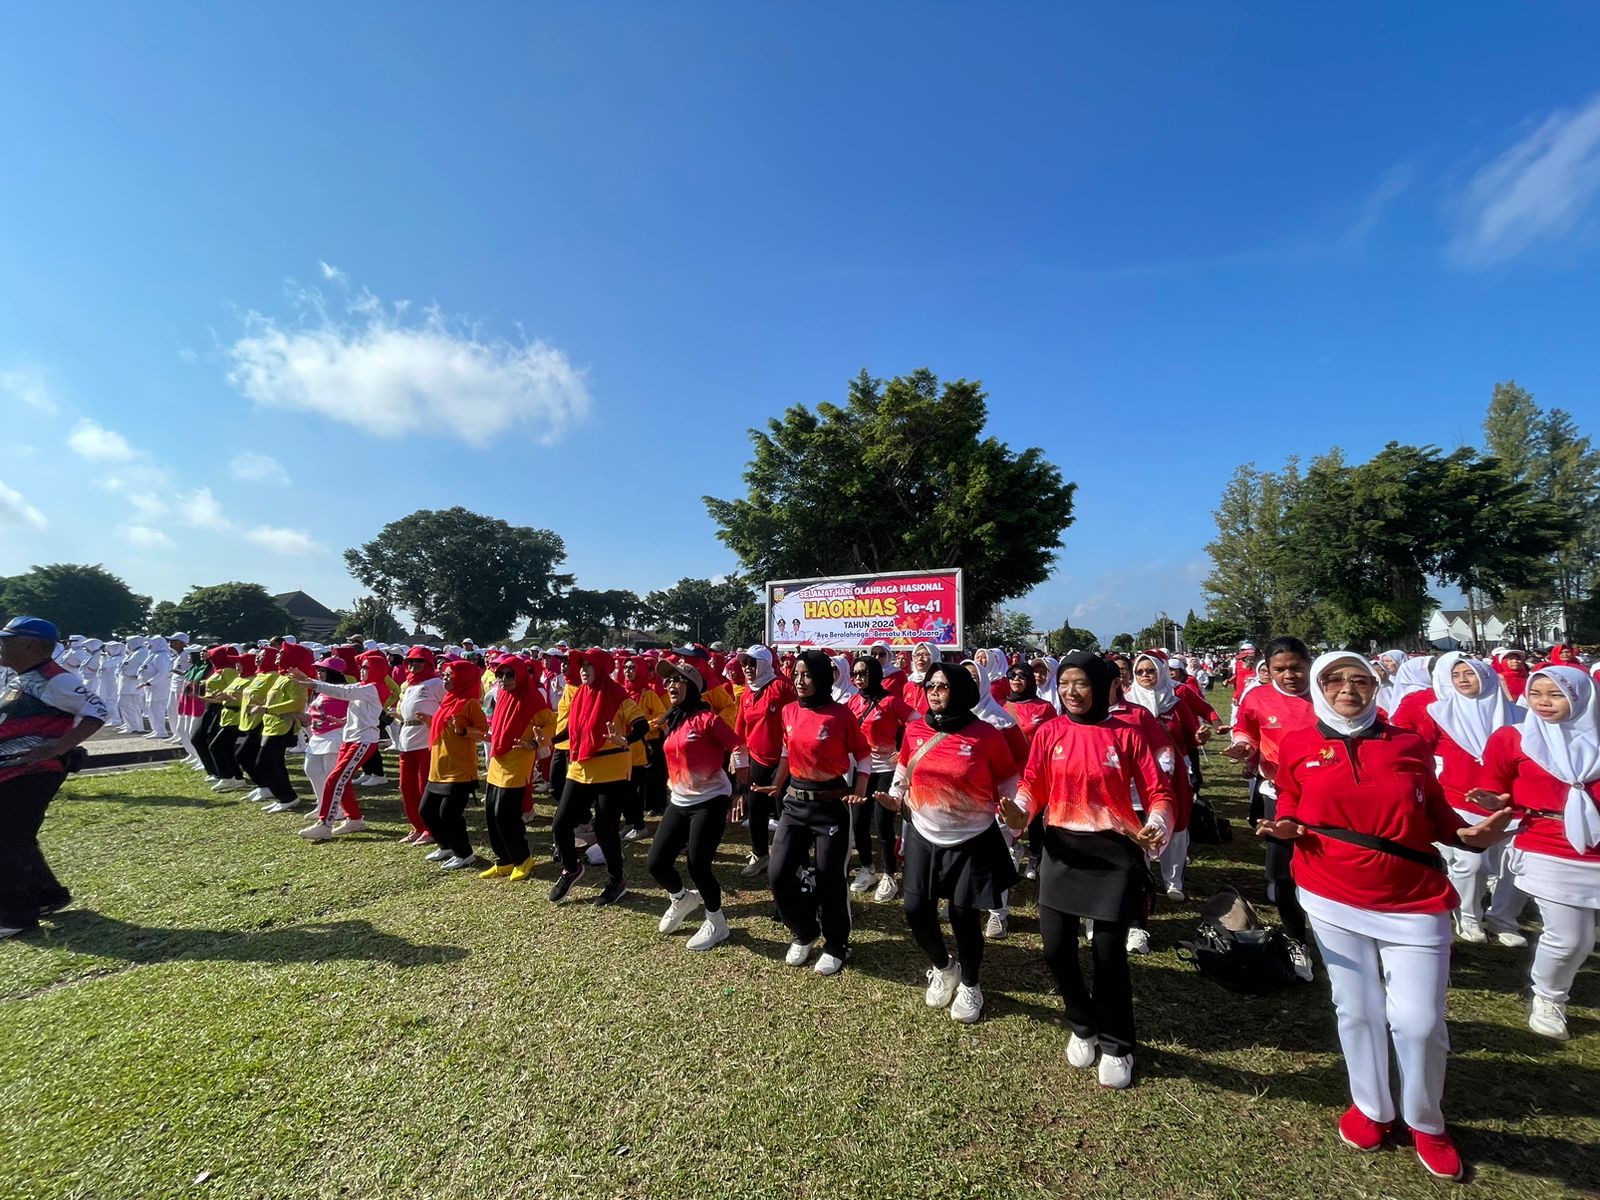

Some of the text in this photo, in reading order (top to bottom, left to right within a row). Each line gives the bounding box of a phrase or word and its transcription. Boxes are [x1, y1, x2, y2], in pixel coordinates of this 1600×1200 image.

[799, 588, 833, 598] SELAMAT
[854, 585, 898, 595] OLAHRAGA
[900, 582, 944, 592] NASIONAL
[804, 597, 941, 619] HAORNAS ke-41
[843, 620, 894, 629] TAHUN 2024
